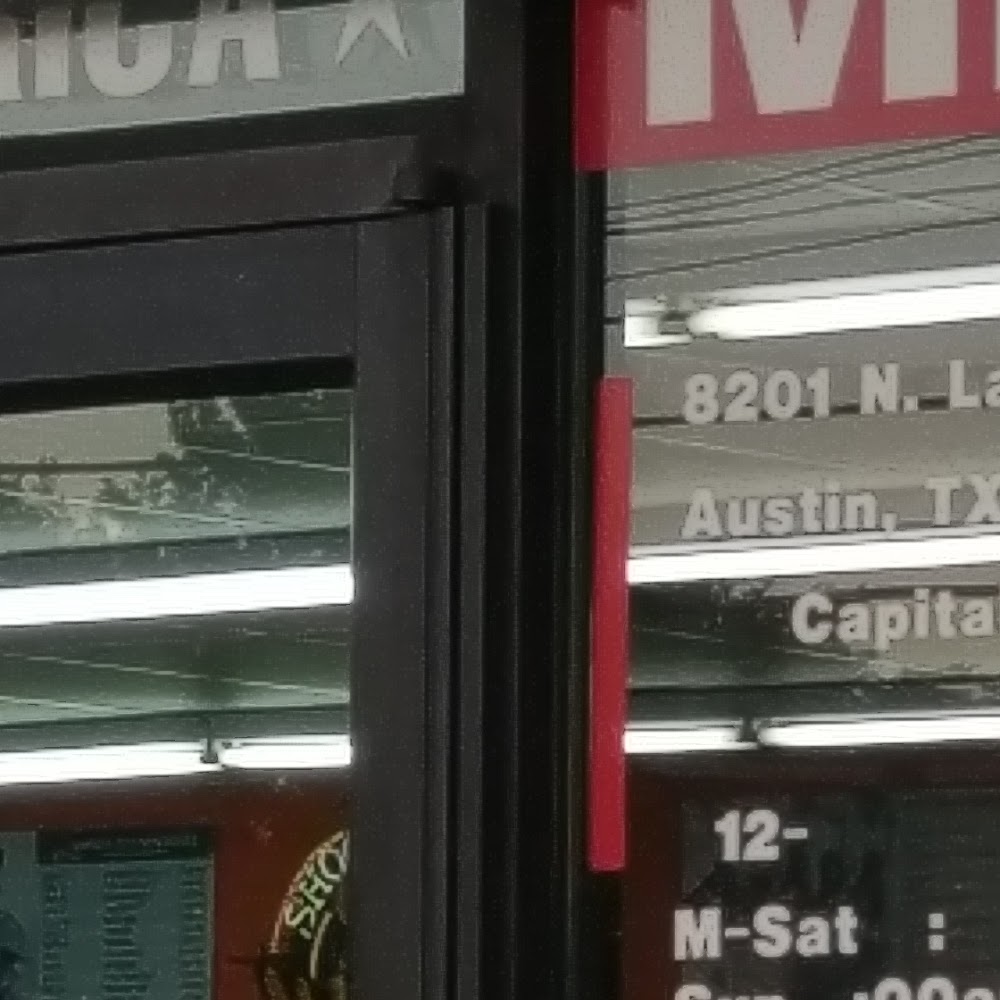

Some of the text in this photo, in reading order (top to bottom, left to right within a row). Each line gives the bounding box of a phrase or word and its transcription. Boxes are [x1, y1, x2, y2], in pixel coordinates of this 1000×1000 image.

[684, 366, 830, 424] 8201
[860, 361, 918, 414] N.
[681, 480, 898, 540] Austin,
[713, 809, 809, 862] 12-
[673, 905, 859, 962] M-Sat
